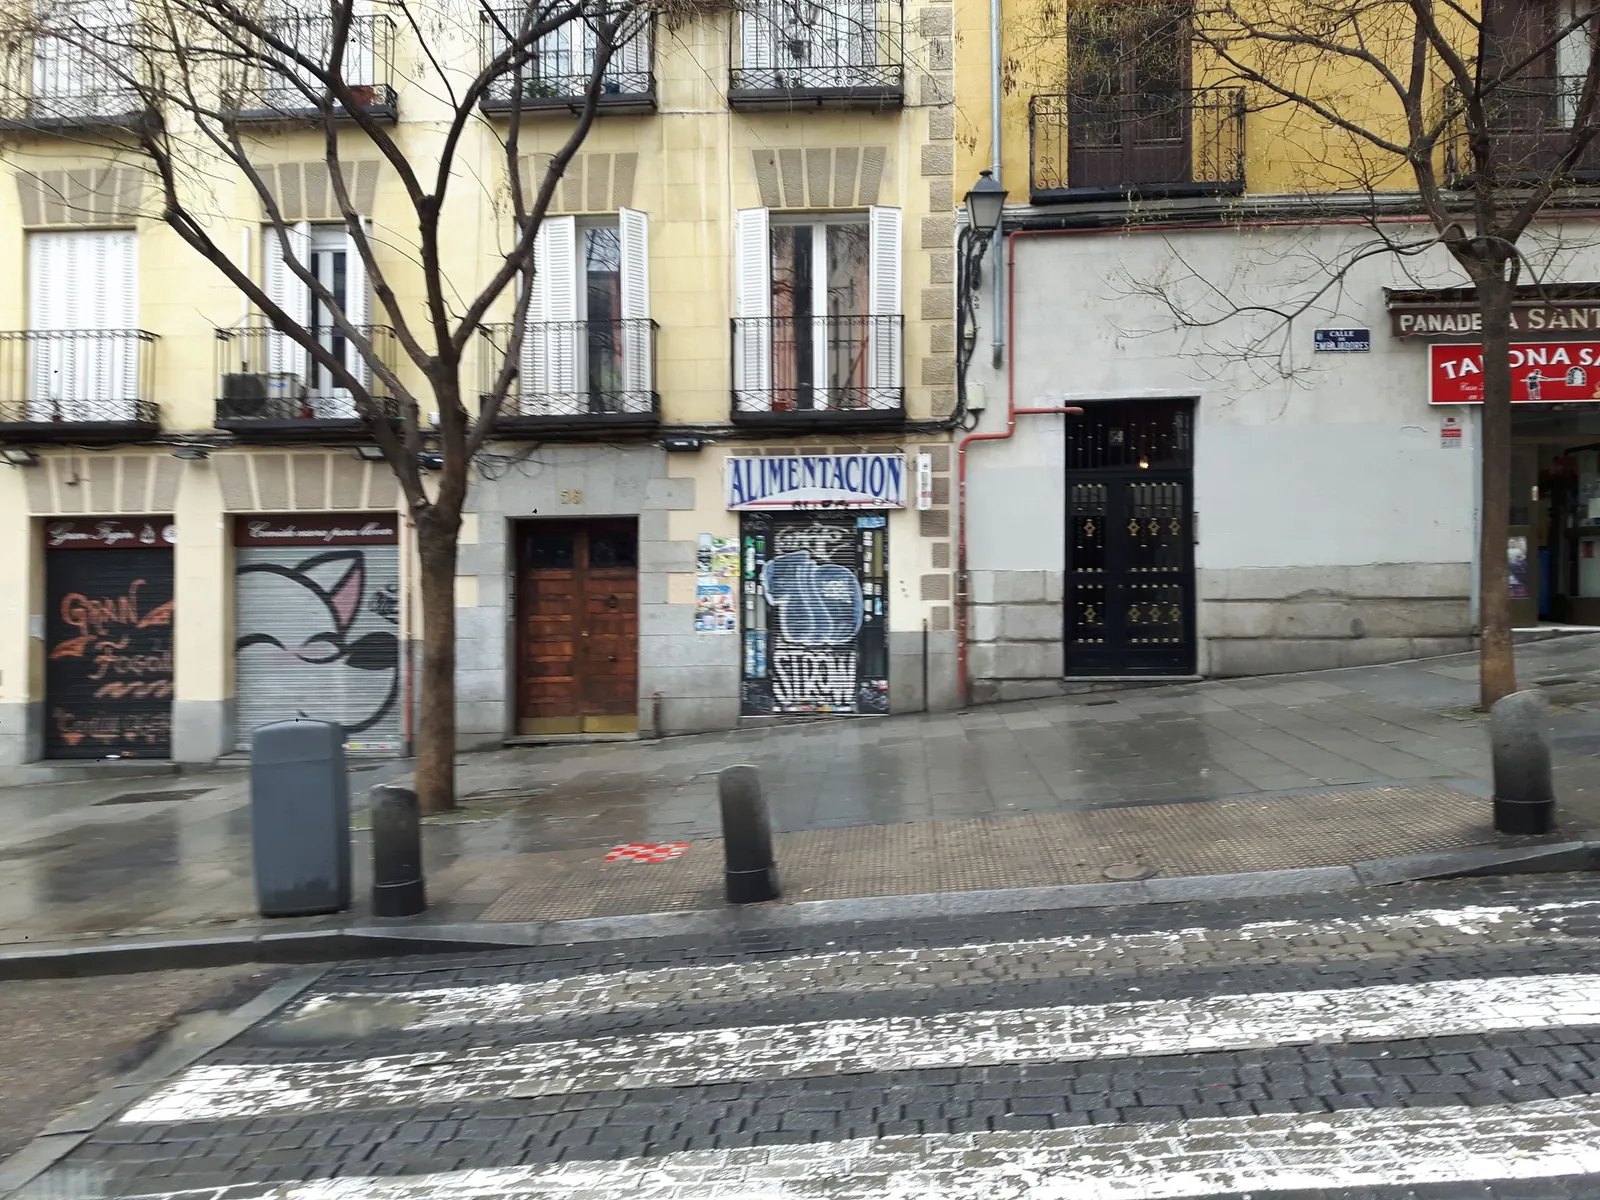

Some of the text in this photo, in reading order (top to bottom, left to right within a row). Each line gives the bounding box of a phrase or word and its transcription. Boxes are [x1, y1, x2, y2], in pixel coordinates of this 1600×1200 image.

[1400, 312, 1519, 332] PANADEA
[1315, 341, 1370, 351] EMBAJADORES
[1440, 347, 1572, 379] TAONA
[731, 456, 903, 506] ALIMENTACION
